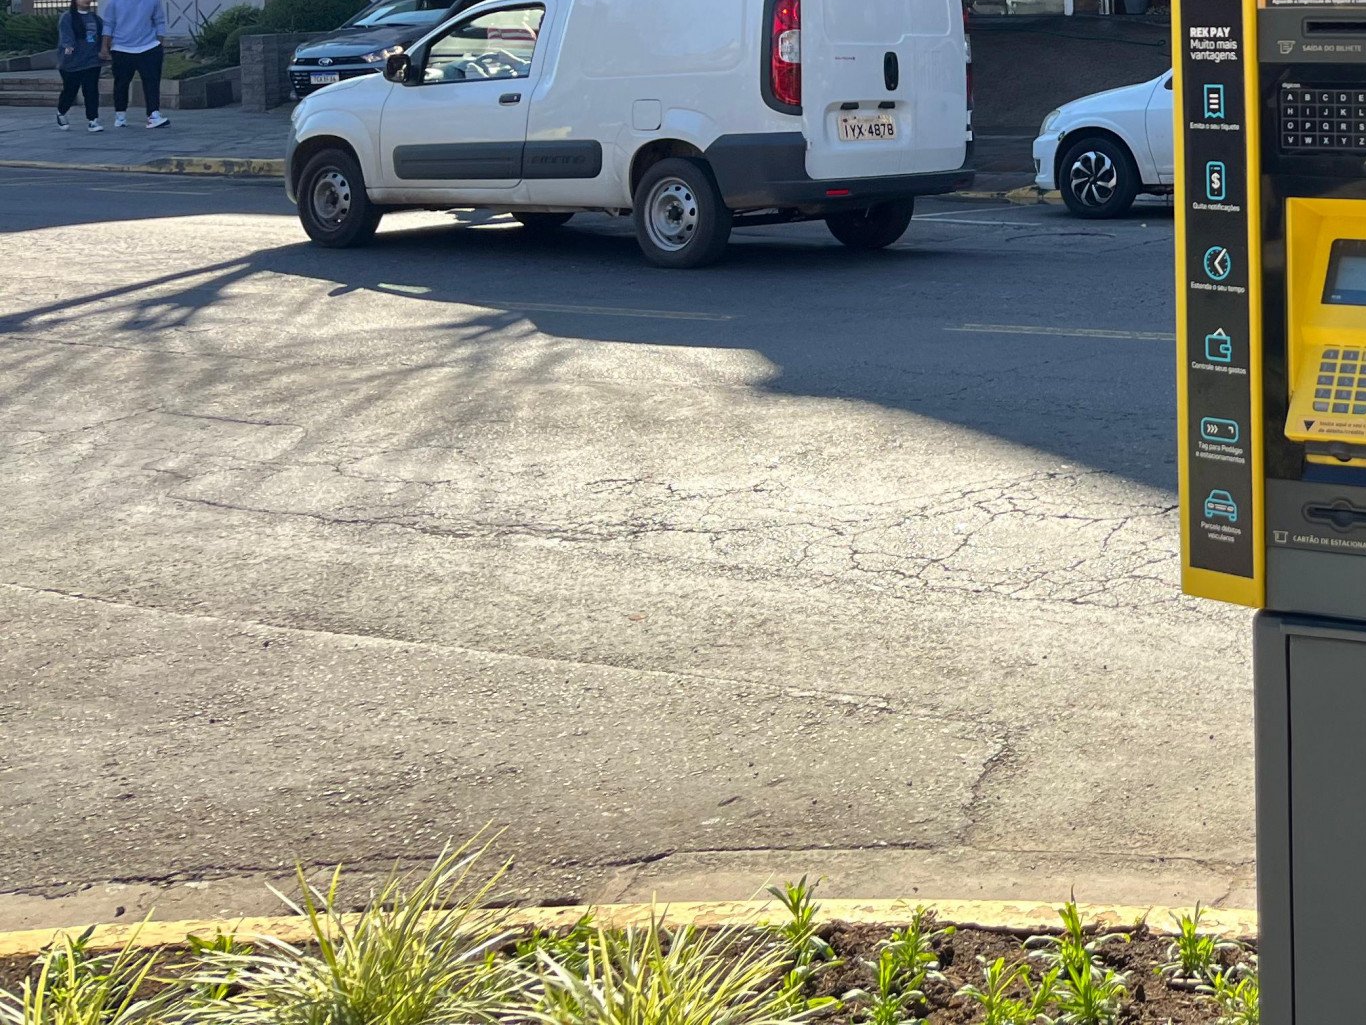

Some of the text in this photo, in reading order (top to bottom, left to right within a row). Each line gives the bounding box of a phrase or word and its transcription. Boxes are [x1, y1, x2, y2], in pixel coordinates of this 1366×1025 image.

[1189, 27, 1231, 37] REK PAY
[1190, 39, 1238, 49] Muito mais
[1190, 51, 1238, 63] vantagens.
[1228, 285, 1245, 294] tempo
[1191, 361, 1214, 371] Controle
[1228, 367, 1247, 375] gastos
[1198, 441, 1208, 451] Tag
[1208, 444, 1221, 452] para
[1292, 534, 1319, 545] CARTÃO
